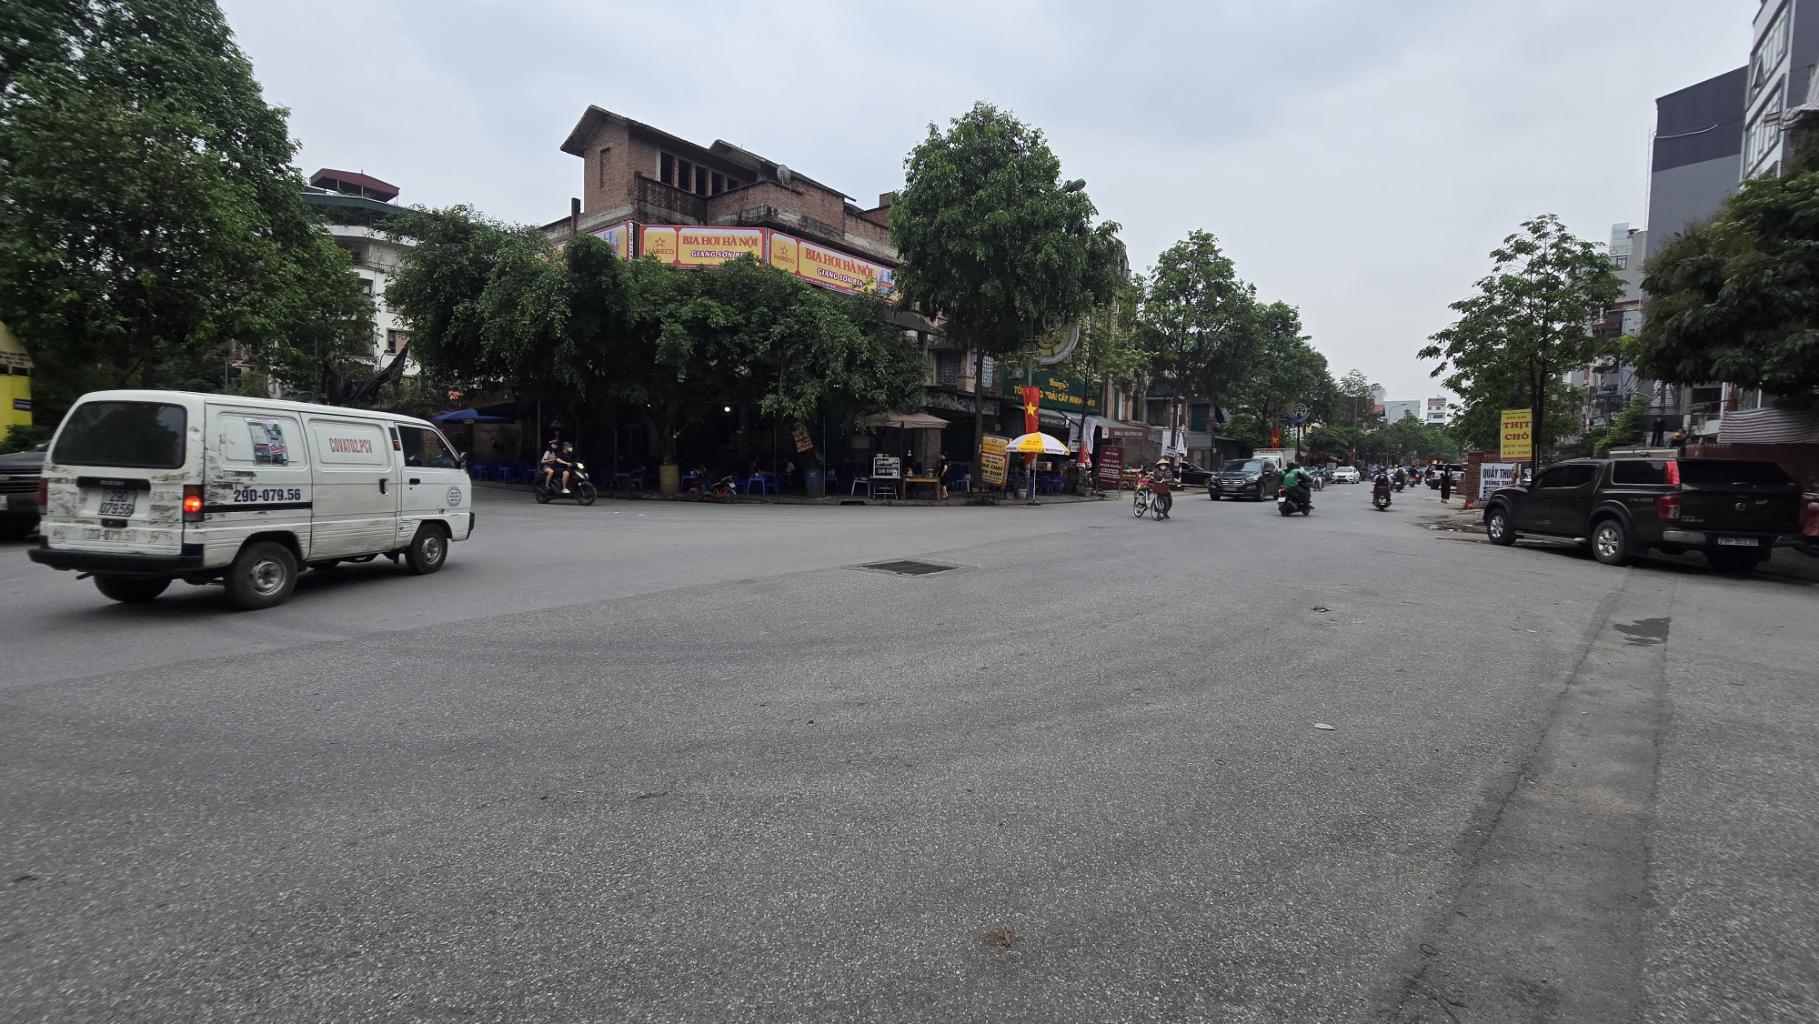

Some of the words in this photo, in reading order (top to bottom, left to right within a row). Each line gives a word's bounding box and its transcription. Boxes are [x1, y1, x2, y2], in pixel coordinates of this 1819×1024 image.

[682, 235, 699, 245] BIA
[722, 235, 738, 246] HÀ
[739, 236, 758, 248] NỘI
[691, 250, 716, 258] GIANG
[805, 248, 824, 264] BIA
[816, 268, 839, 281] GIANG
[1504, 422, 1530, 430] THỊT
[1504, 432, 1530, 440] CHÓ
[234, 488, 300, 502] 29D-079.56
